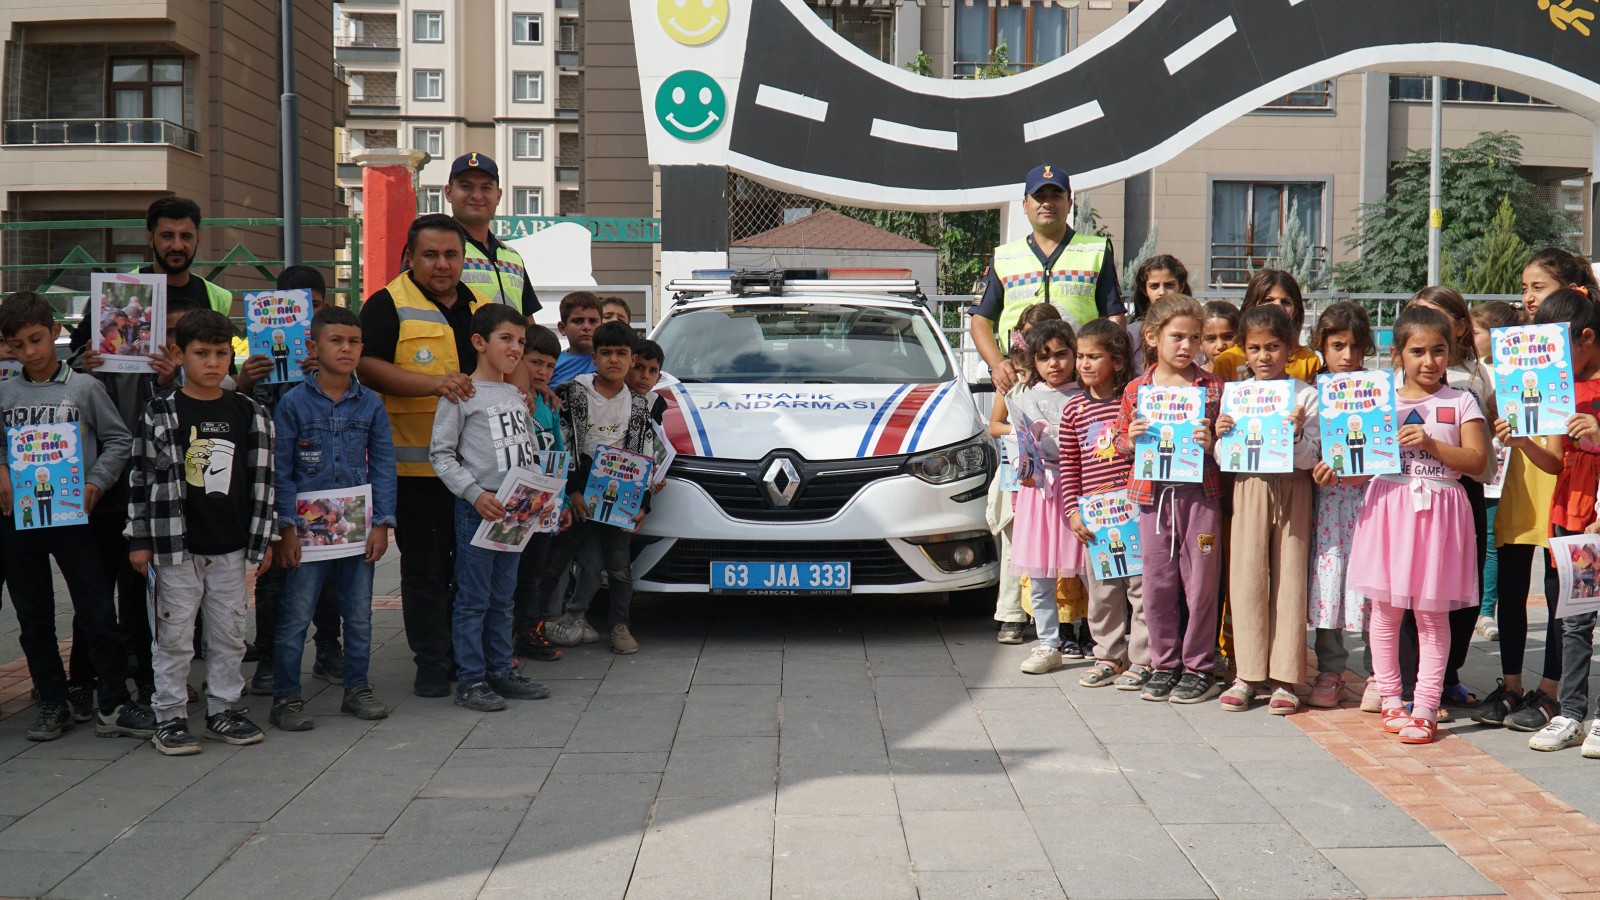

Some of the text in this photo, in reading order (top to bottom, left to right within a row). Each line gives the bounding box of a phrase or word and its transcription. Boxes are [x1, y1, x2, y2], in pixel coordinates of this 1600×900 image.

[496, 219, 620, 238] BABON
[1502, 343, 1556, 355] BOYAMA
[1328, 388, 1381, 400] BOYAMA
[700, 401, 876, 410] JANDARMASI
[499, 410, 526, 437] FAS
[17, 440, 68, 452] BOYAMA
[1414, 465, 1445, 478] GAME!
[724, 564, 846, 587] 63 JAA 333
